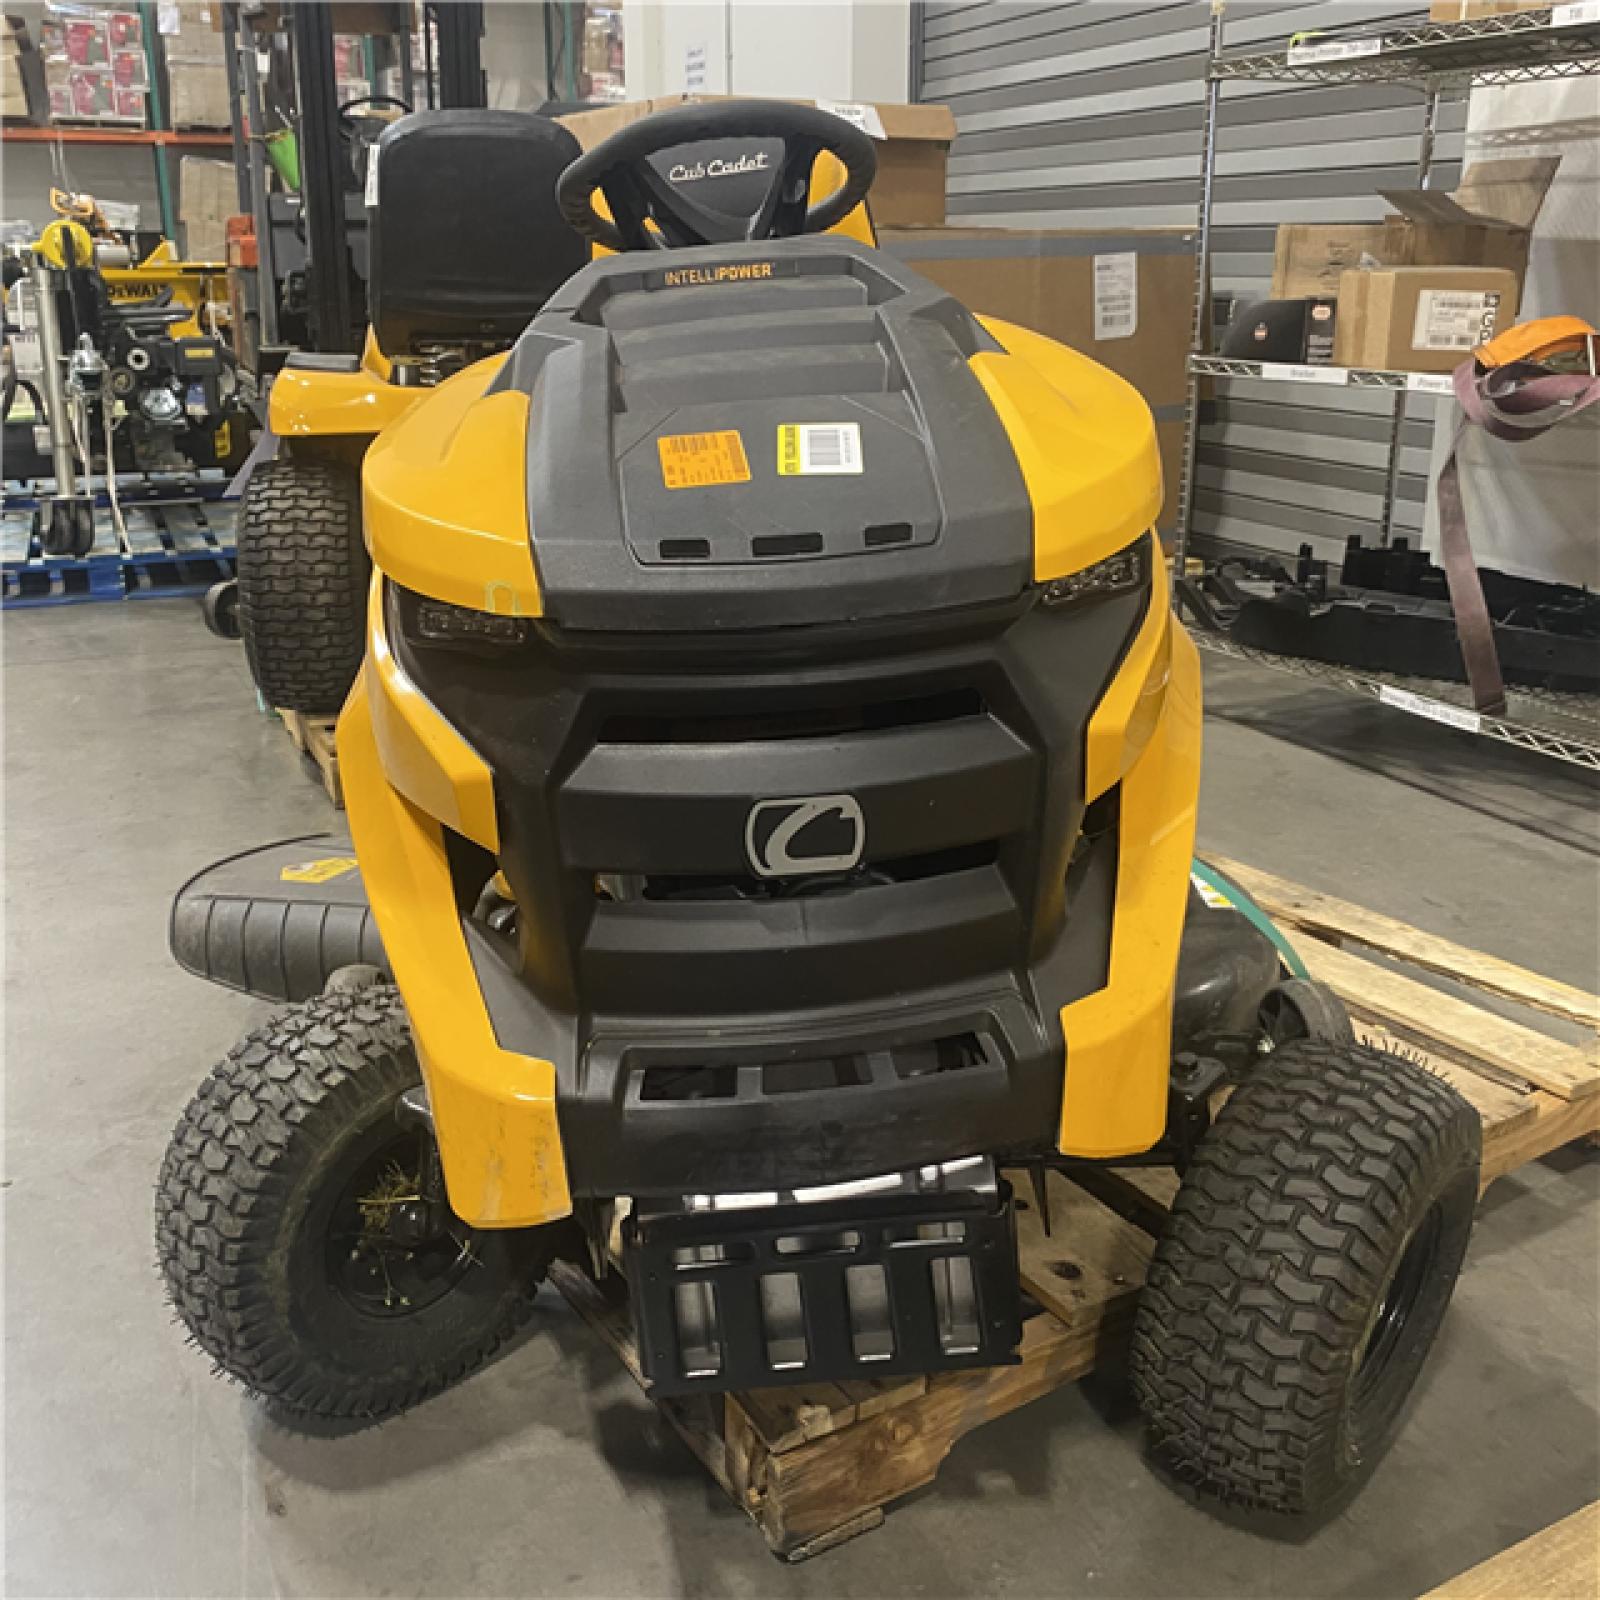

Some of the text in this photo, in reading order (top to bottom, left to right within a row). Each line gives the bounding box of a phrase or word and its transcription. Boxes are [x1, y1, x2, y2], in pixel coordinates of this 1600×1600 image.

[669, 152, 769, 181] Cub Cadet
[664, 262, 771, 285] INTELLIPOWER
